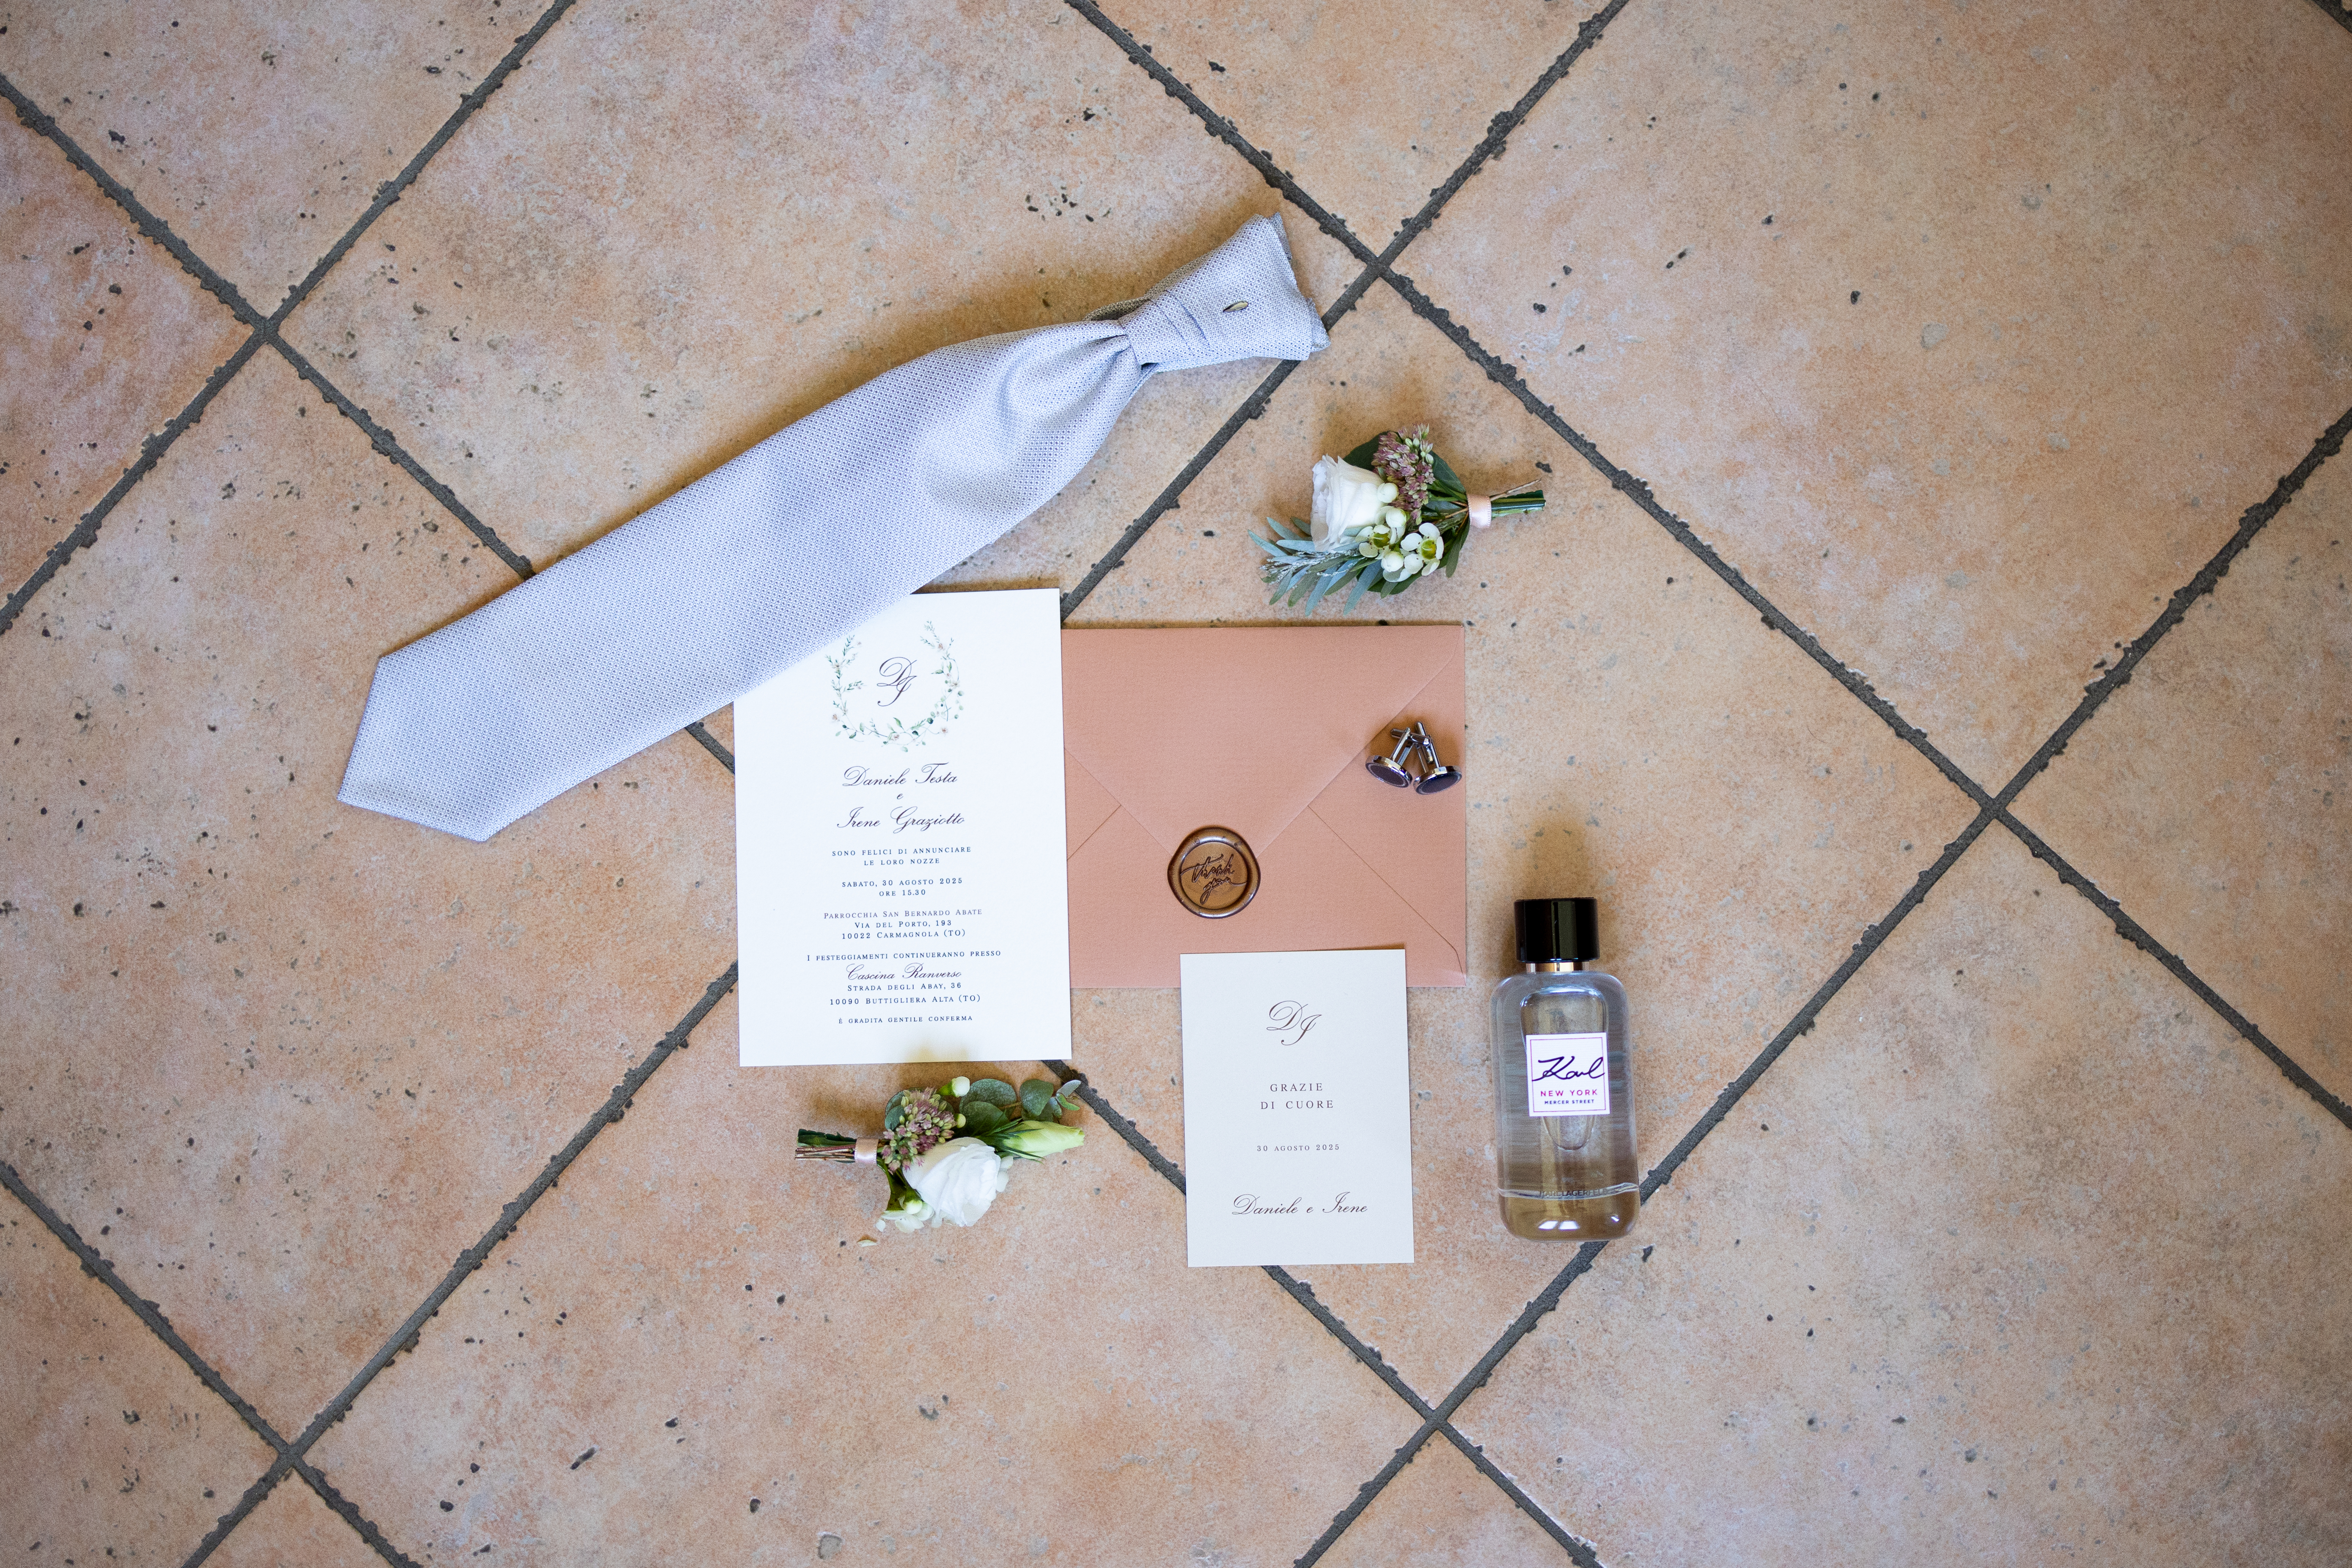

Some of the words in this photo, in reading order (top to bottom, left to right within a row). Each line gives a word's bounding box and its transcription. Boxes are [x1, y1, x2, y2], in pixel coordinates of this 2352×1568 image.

[842, 766, 910, 786] Daniele
[915, 762, 957, 783] Testa
[837, 807, 880, 828] Irene
[890, 806, 964, 834] Graziotto
[943, 928, 965, 937] (TO)
[846, 963, 895, 980] Cascina
[902, 963, 962, 978] Ranverso
[959, 994, 980, 1003] (TO)
[1532, 1055, 1605, 1081] Karl
[1270, 1083, 1322, 1092] GRAZIE
[1261, 1101, 1274, 1109] DI
[1286, 1100, 1333, 1109] CUORE
[1231, 1194, 1302, 1215] Daniele
[1322, 1192, 1368, 1213] Irene
